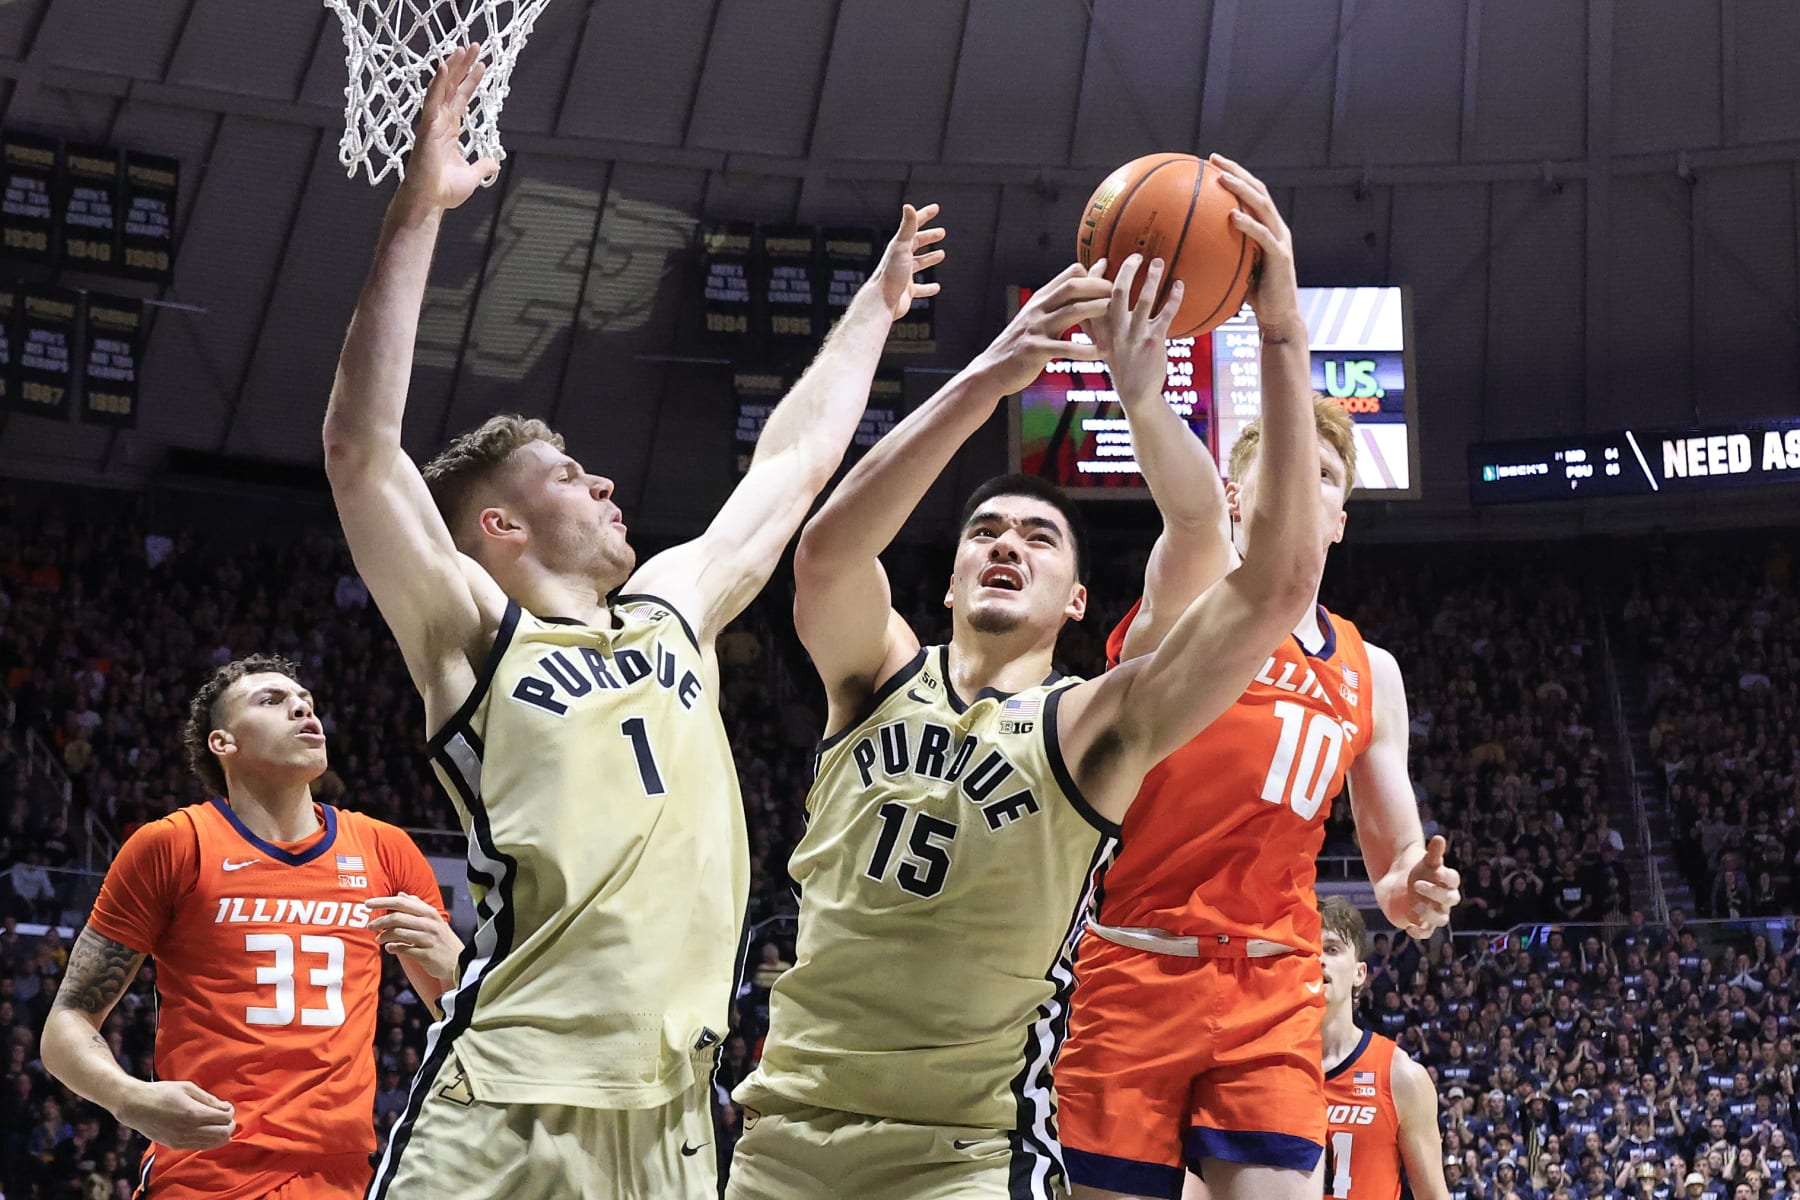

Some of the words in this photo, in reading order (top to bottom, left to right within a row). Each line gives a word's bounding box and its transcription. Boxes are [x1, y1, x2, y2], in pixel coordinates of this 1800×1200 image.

[1662, 434, 1752, 479] NEED
[511, 641, 702, 717] PURDUE
[620, 717, 667, 797] 1
[851, 720, 1042, 833] PURDUE
[1261, 700, 1343, 821] 10
[865, 802, 959, 900] 15
[214, 897, 373, 929] ILLINOIS
[245, 934, 345, 1026] 33
